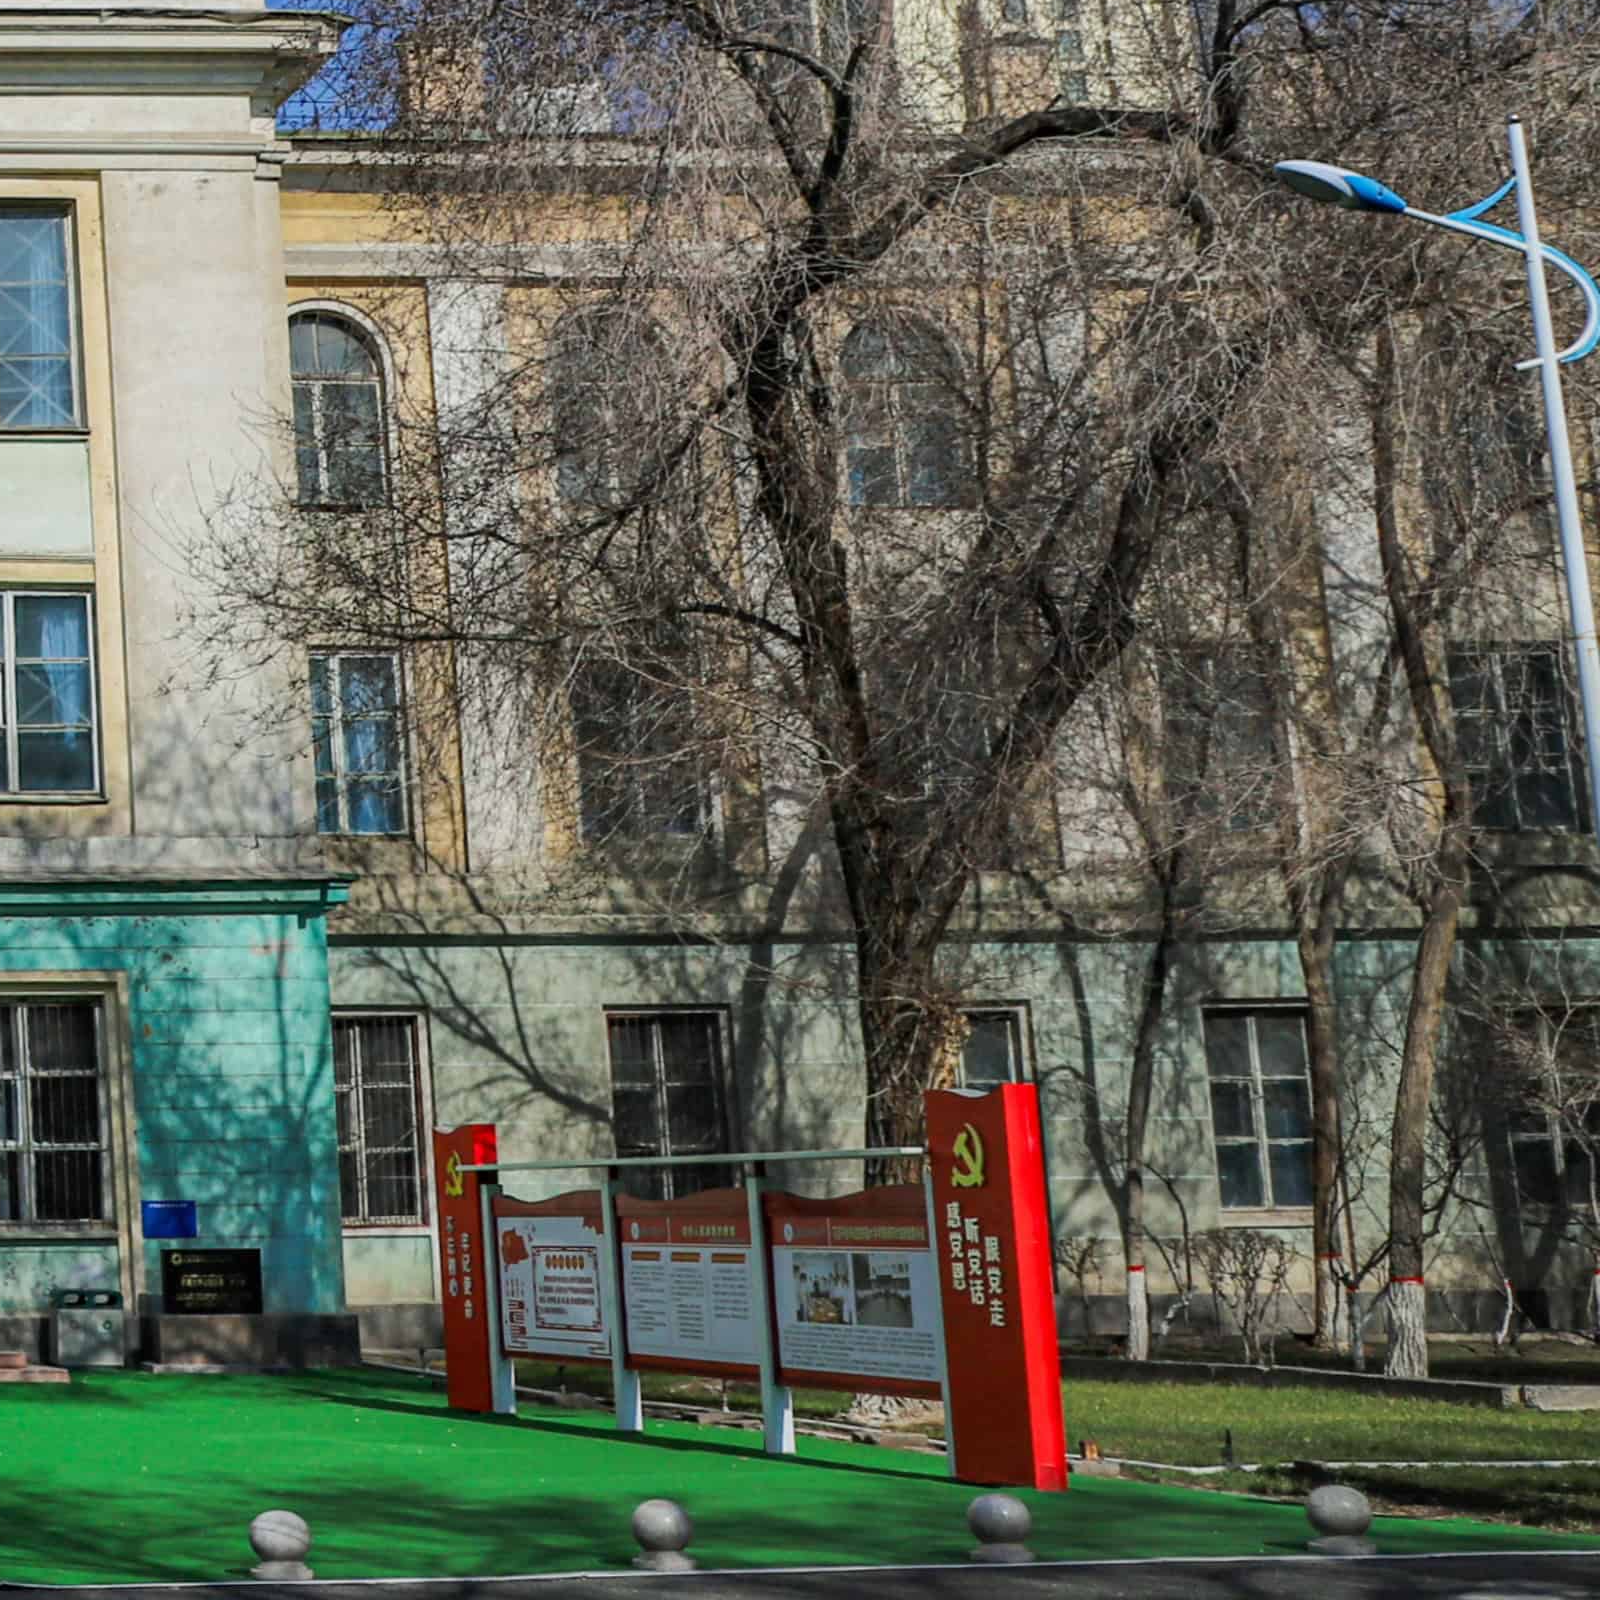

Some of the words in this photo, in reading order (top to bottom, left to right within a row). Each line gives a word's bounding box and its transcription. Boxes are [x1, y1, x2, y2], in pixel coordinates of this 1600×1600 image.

[946, 1201, 967, 1291] 感党恩
[964, 1217, 985, 1305] 听党话
[984, 1235, 1006, 1327] 跟党走
